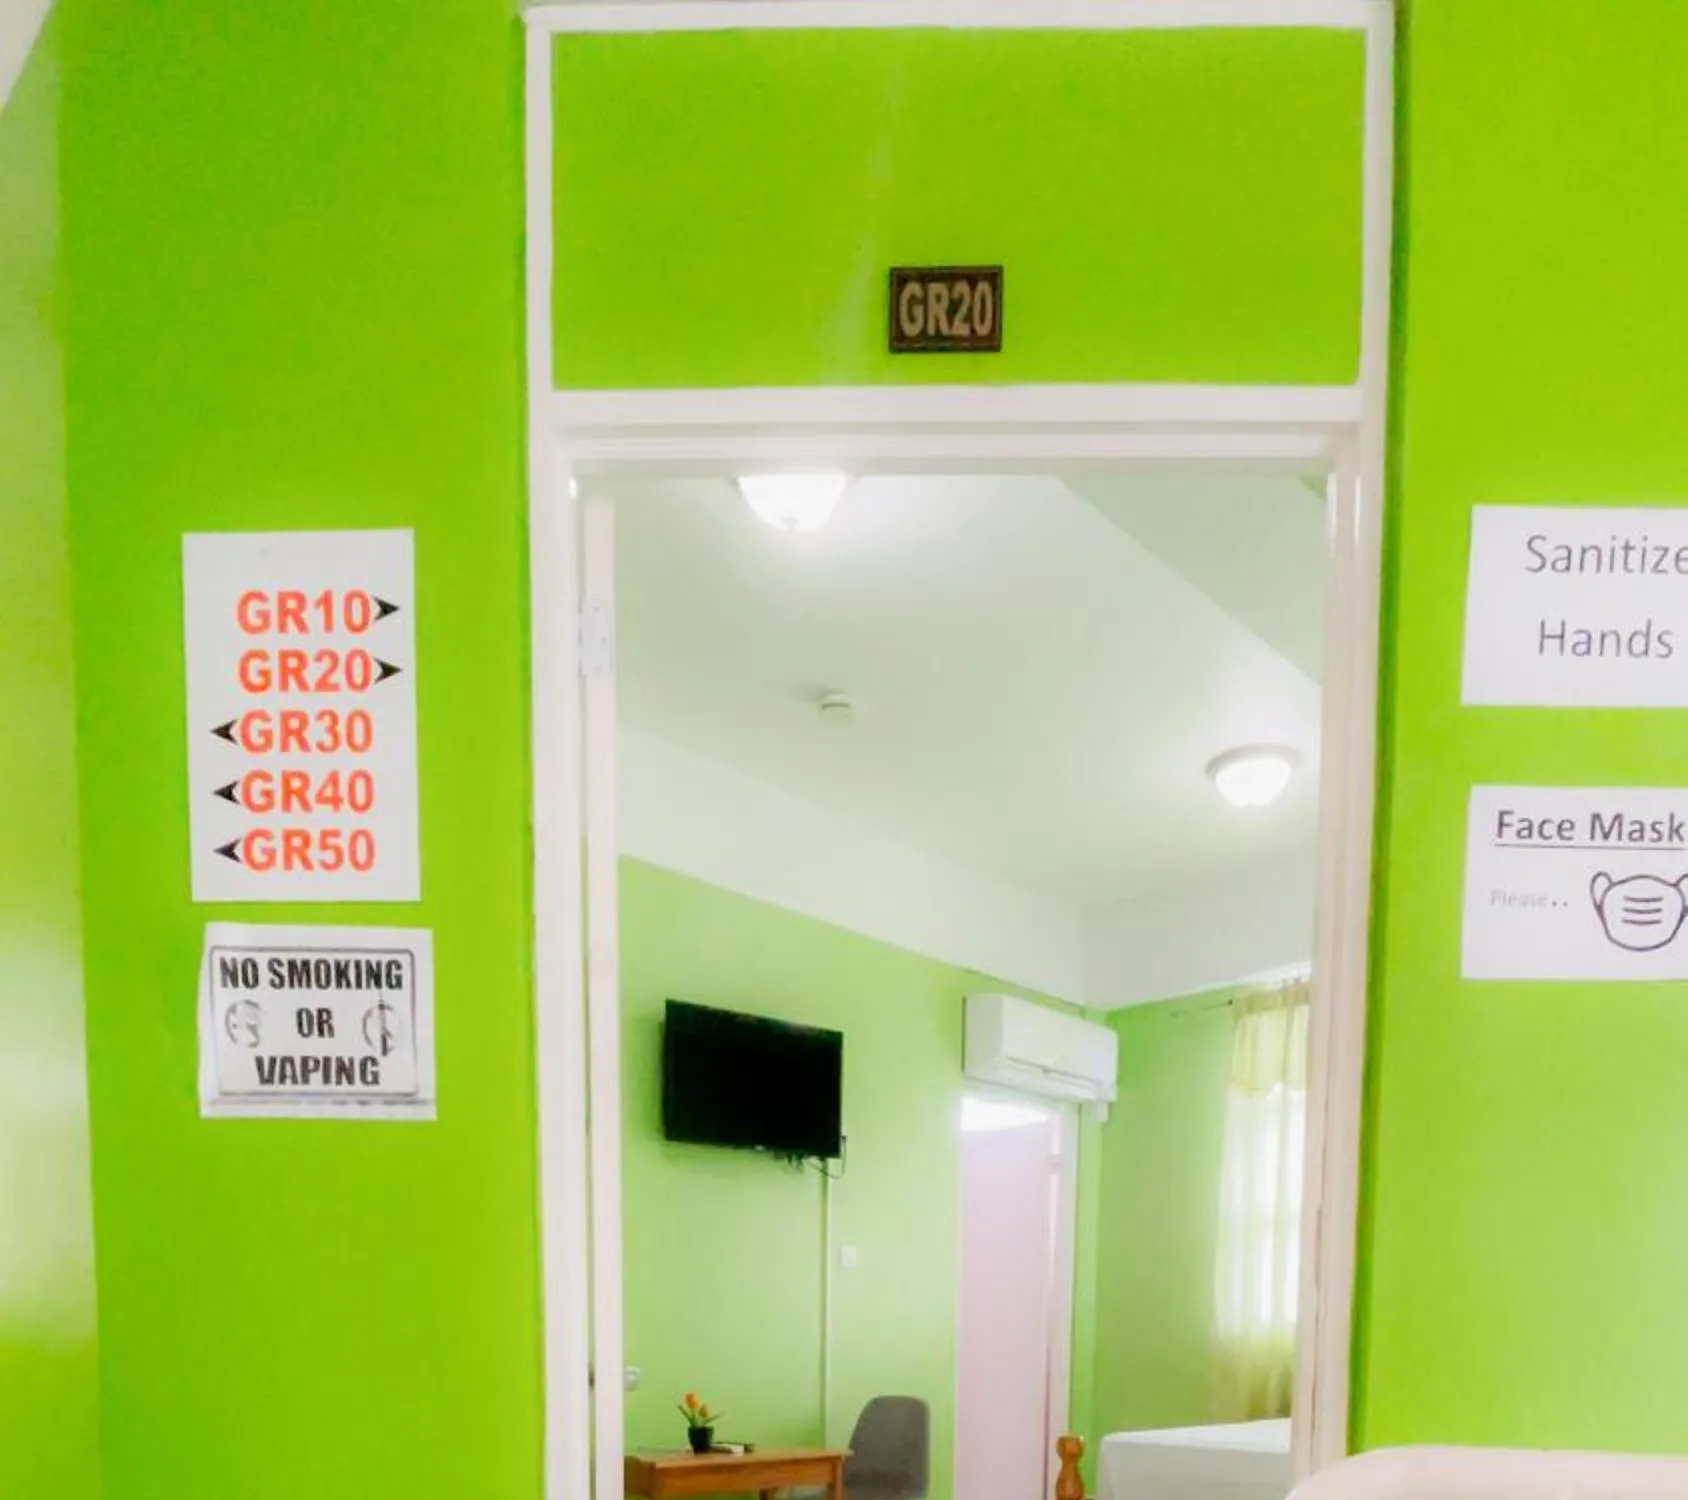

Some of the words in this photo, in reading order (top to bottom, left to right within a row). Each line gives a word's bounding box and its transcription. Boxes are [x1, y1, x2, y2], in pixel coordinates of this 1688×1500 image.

[899, 280, 994, 337] GR20
[1525, 534, 1688, 574] Sanitize
[236, 589, 371, 635] GR10
[1538, 618, 1674, 659] Hands
[238, 648, 372, 693] GR20
[239, 708, 374, 754] GR30
[241, 769, 375, 814] GR40
[1496, 810, 1575, 841] Face
[1589, 811, 1685, 843] Mask
[242, 828, 376, 873] GR50
[219, 957, 259, 989] NO
[267, 957, 404, 990] SMOKING
[296, 1007, 336, 1038] OR
[255, 1055, 381, 1086] VAPING
